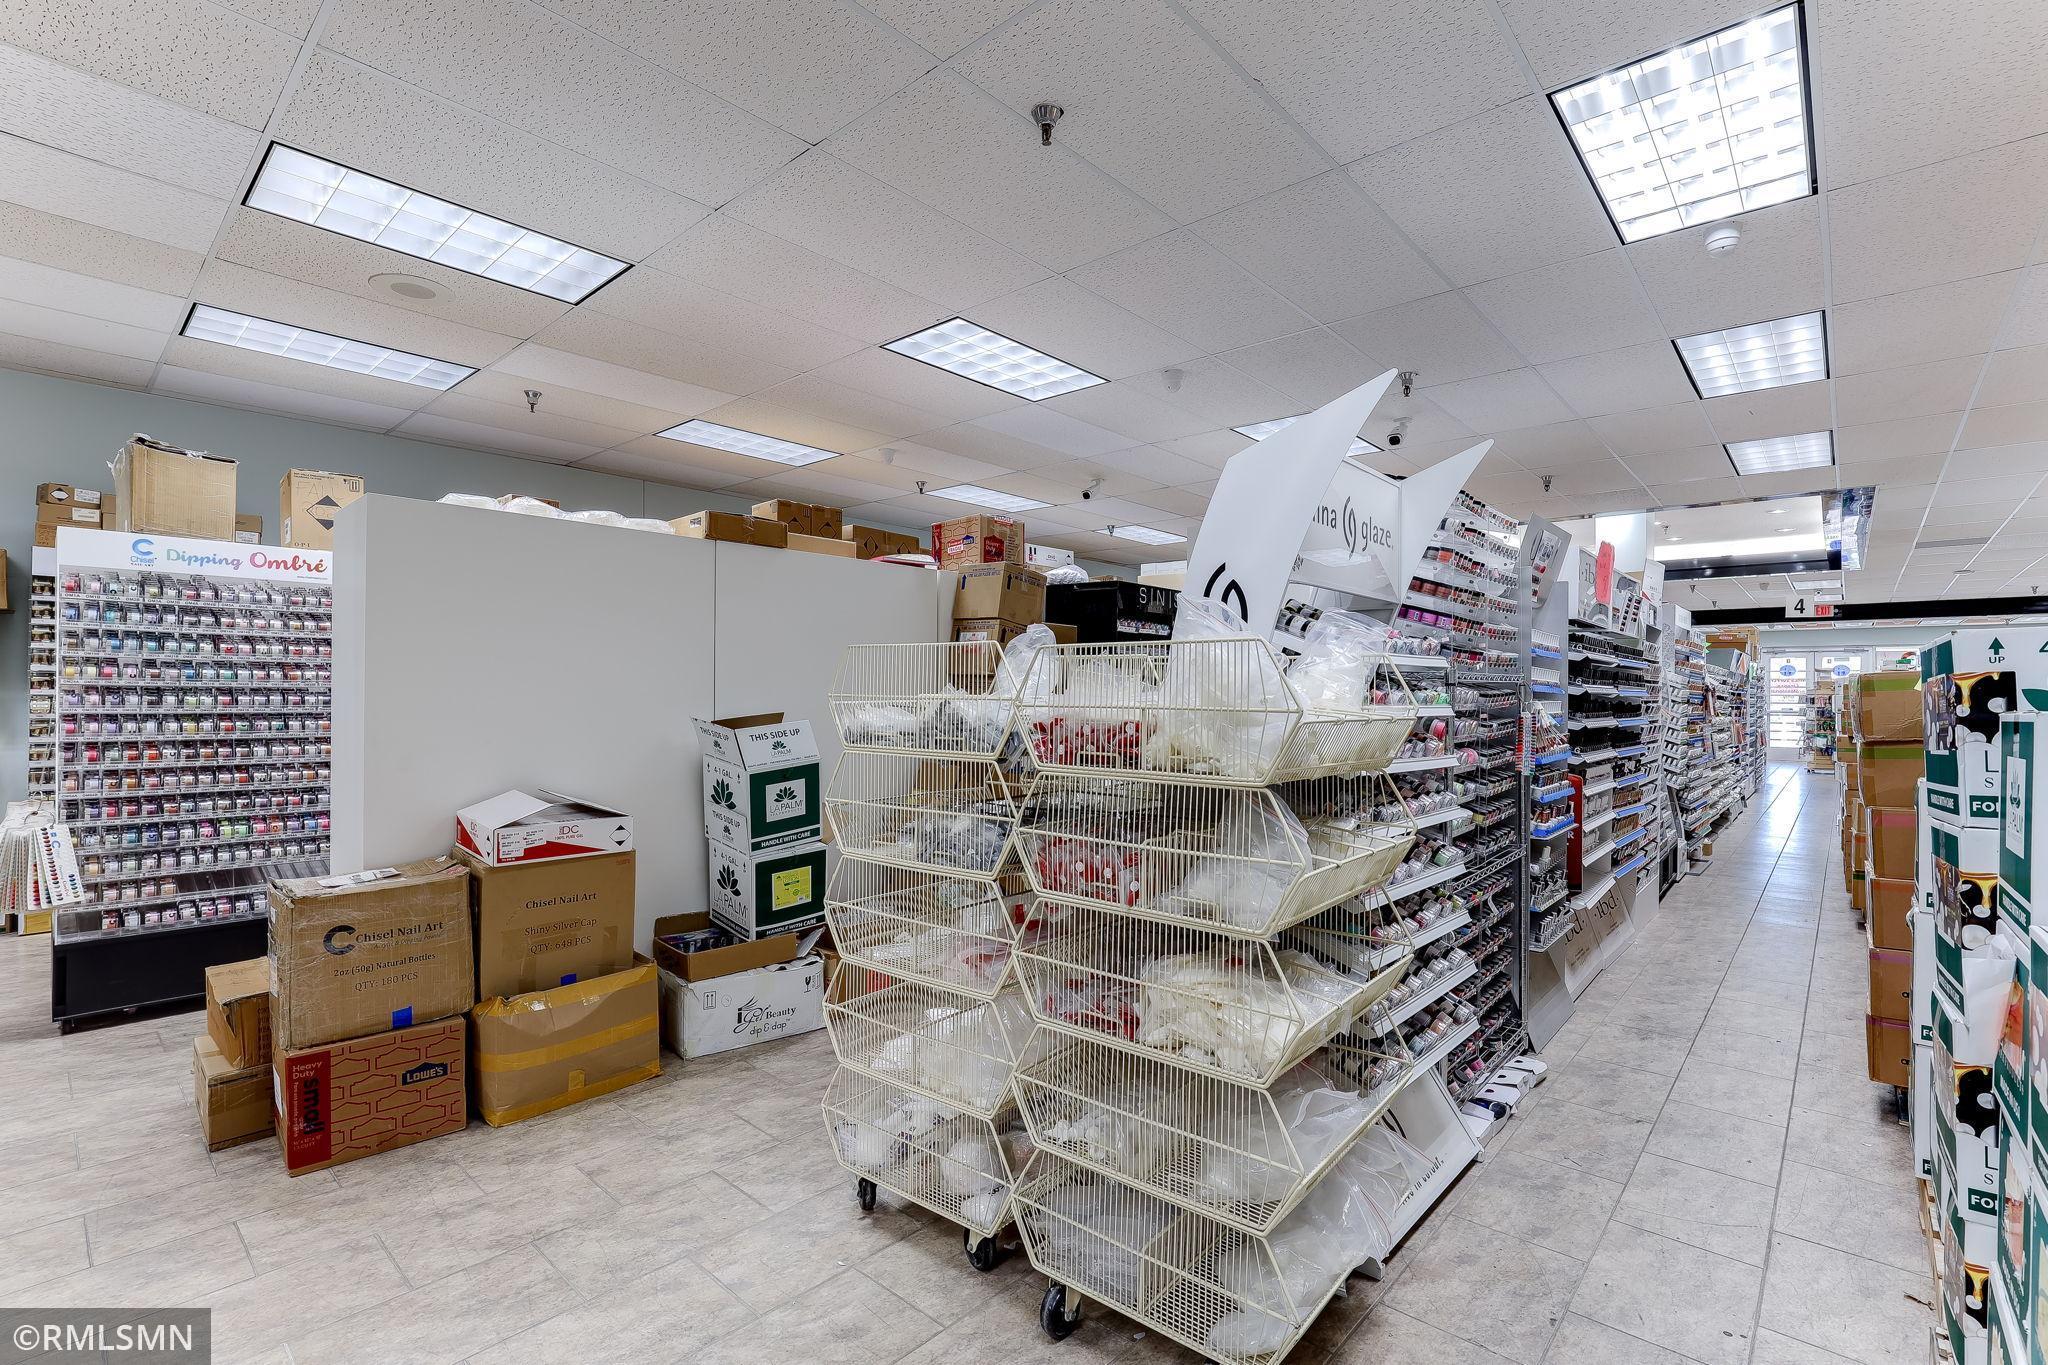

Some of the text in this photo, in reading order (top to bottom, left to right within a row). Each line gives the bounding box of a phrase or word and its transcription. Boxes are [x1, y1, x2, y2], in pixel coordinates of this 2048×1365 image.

[1313, 505, 1392, 552] ina glaze
[130, 555, 154, 564] Chisel
[166, 549, 328, 573] Dipping Ombré
[1794, 599, 1806, 614] 4
[1815, 606, 1831, 616] EXIT
[1988, 656, 2005, 664] UP
[749, 728, 801, 742] THIS SIDE UP
[769, 800, 804, 813] LAPALM
[761, 831, 811, 848] HANDLE WITH CARE
[525, 892, 597, 910] Chisel Nail Art
[355, 921, 444, 944] Chisel Nail Art
[524, 917, 598, 937] Shiny Silver Cap
[766, 918, 817, 935] HANDLE WITH CARE
[530, 935, 592, 955] QTY: 648 PCS
[333, 968, 350, 978] 2oz
[352, 964, 375, 976] (50g)
[376, 958, 407, 970] Natural
[354, 971, 418, 992] QTY: 180 PCS
[766, 1006, 797, 1019] Beauty
[749, 1025, 762, 1037] dip
[763, 1022, 770, 1032] &
[292, 1061, 323, 1073] Heavy
[292, 1070, 315, 1080] Duty
[406, 1067, 444, 1083] LOWE'S
[303, 1077, 326, 1134] small
